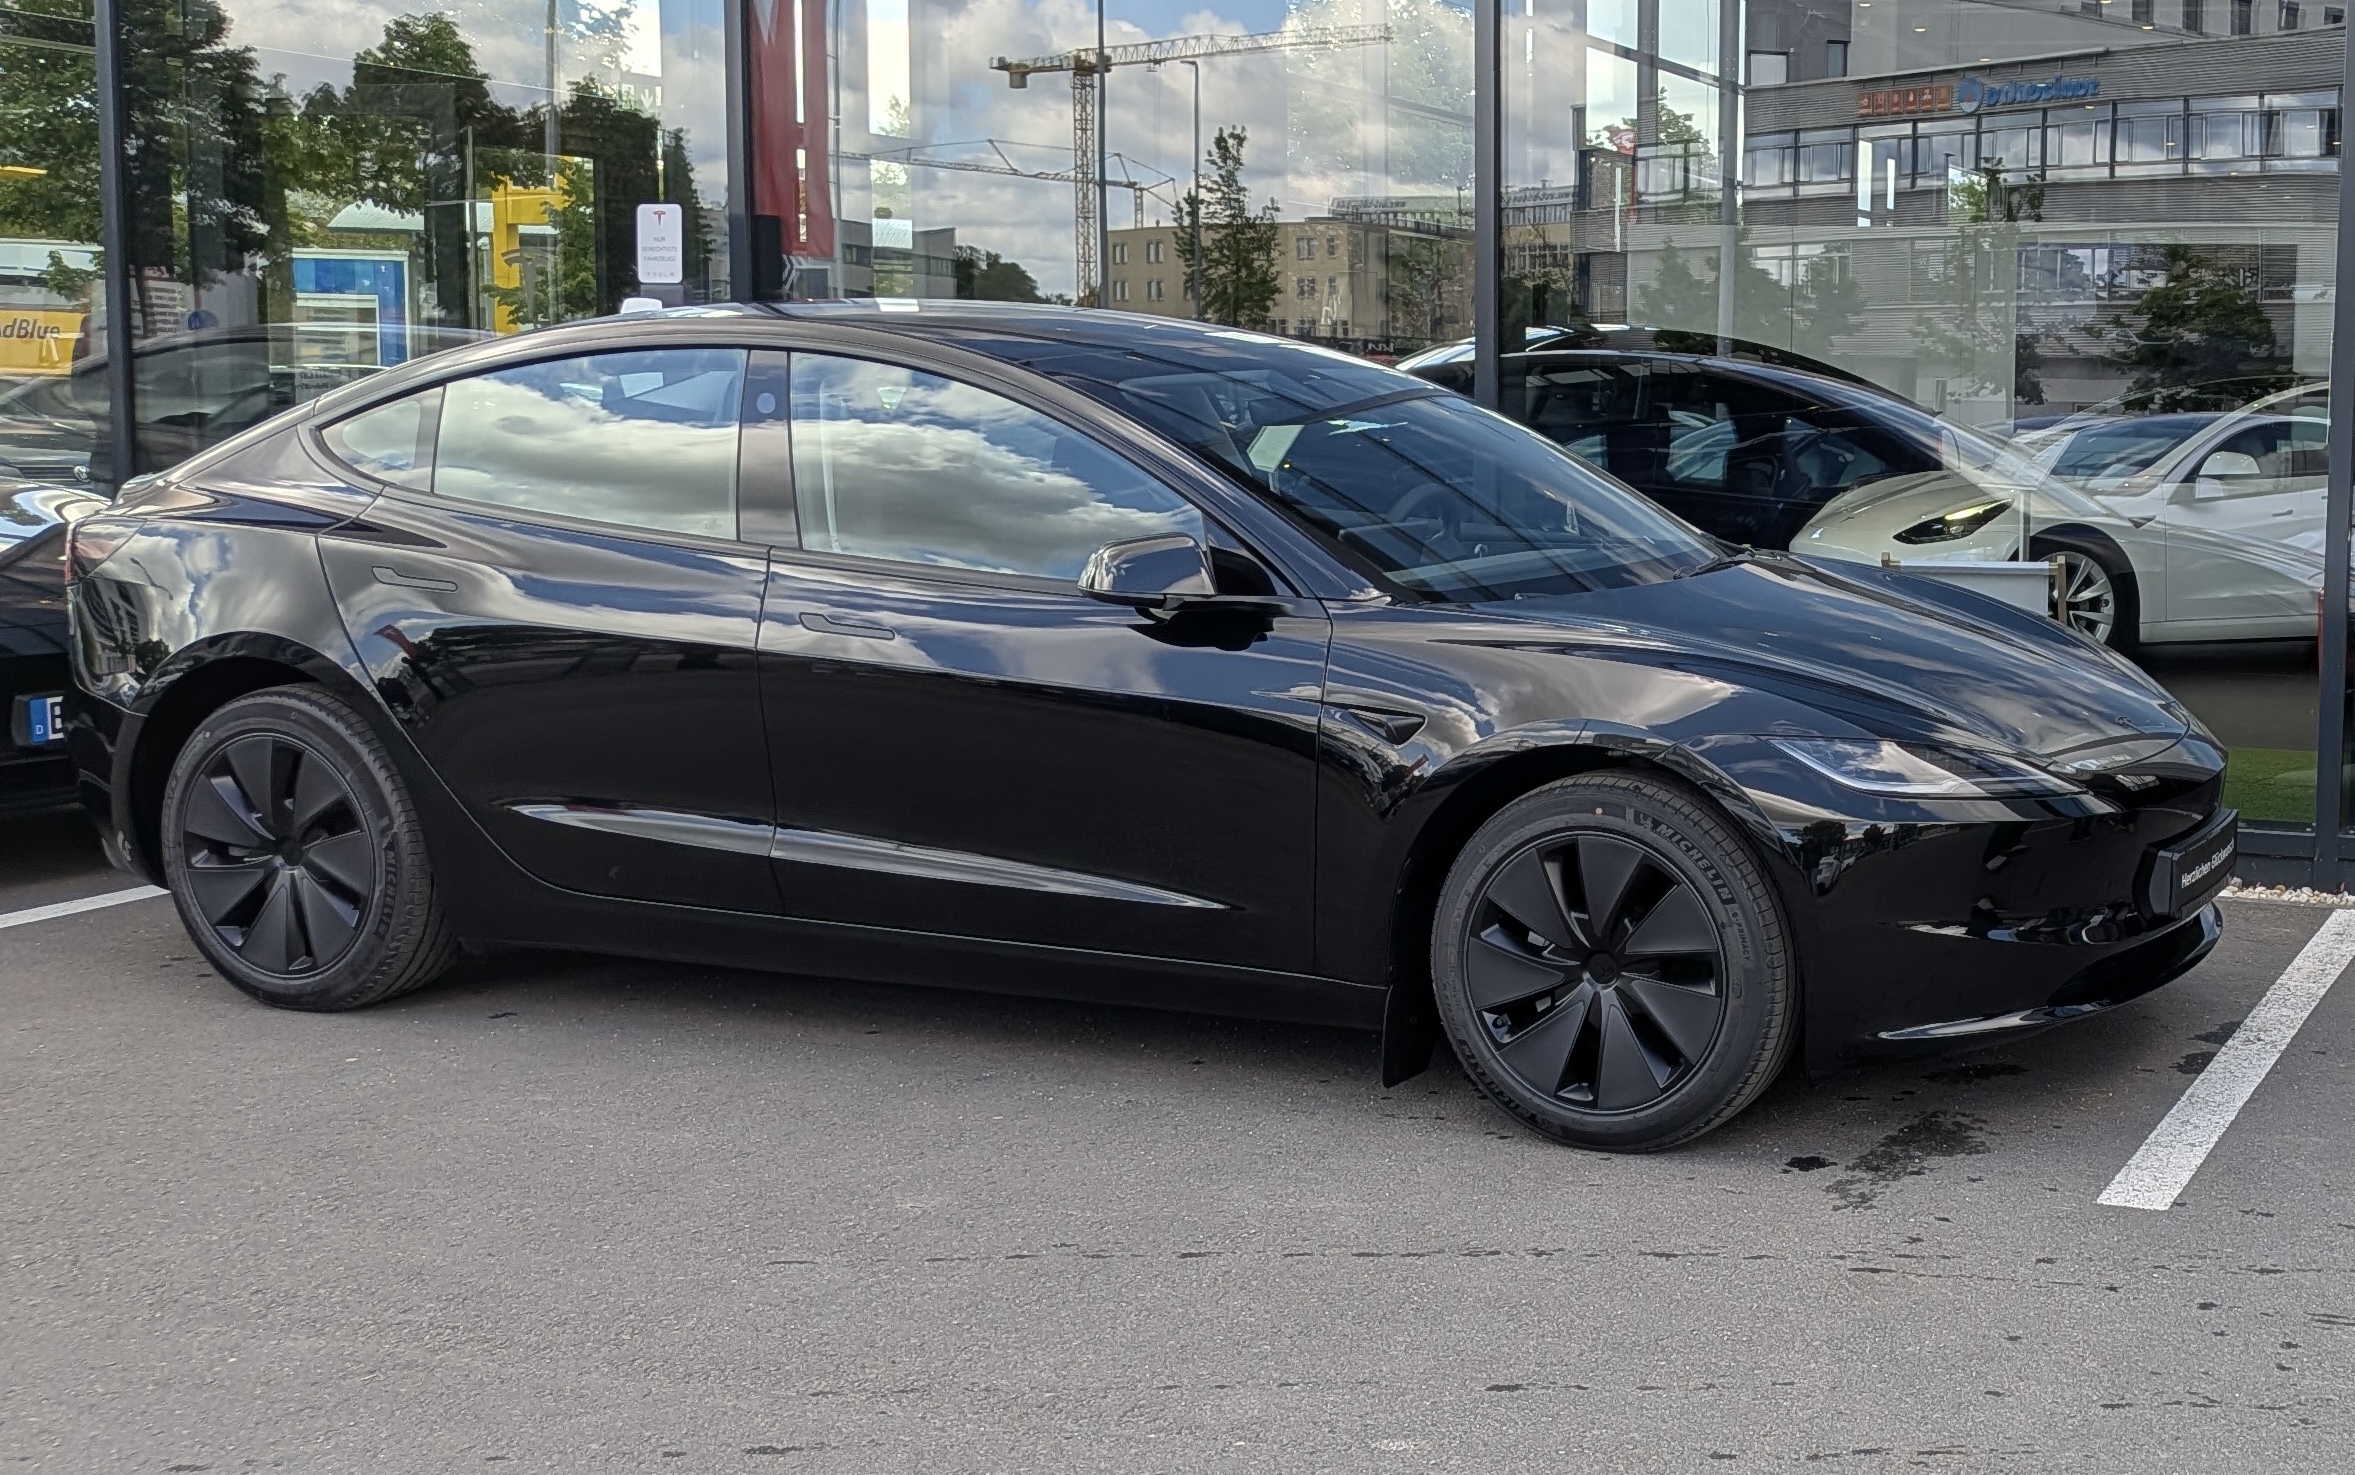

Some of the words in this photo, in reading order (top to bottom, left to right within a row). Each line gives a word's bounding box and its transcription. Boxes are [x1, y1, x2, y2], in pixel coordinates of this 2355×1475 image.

[0, 317, 60, 339] dBlue
[36, 724, 44, 735] D
[1656, 822, 1734, 901] MICHELIN
